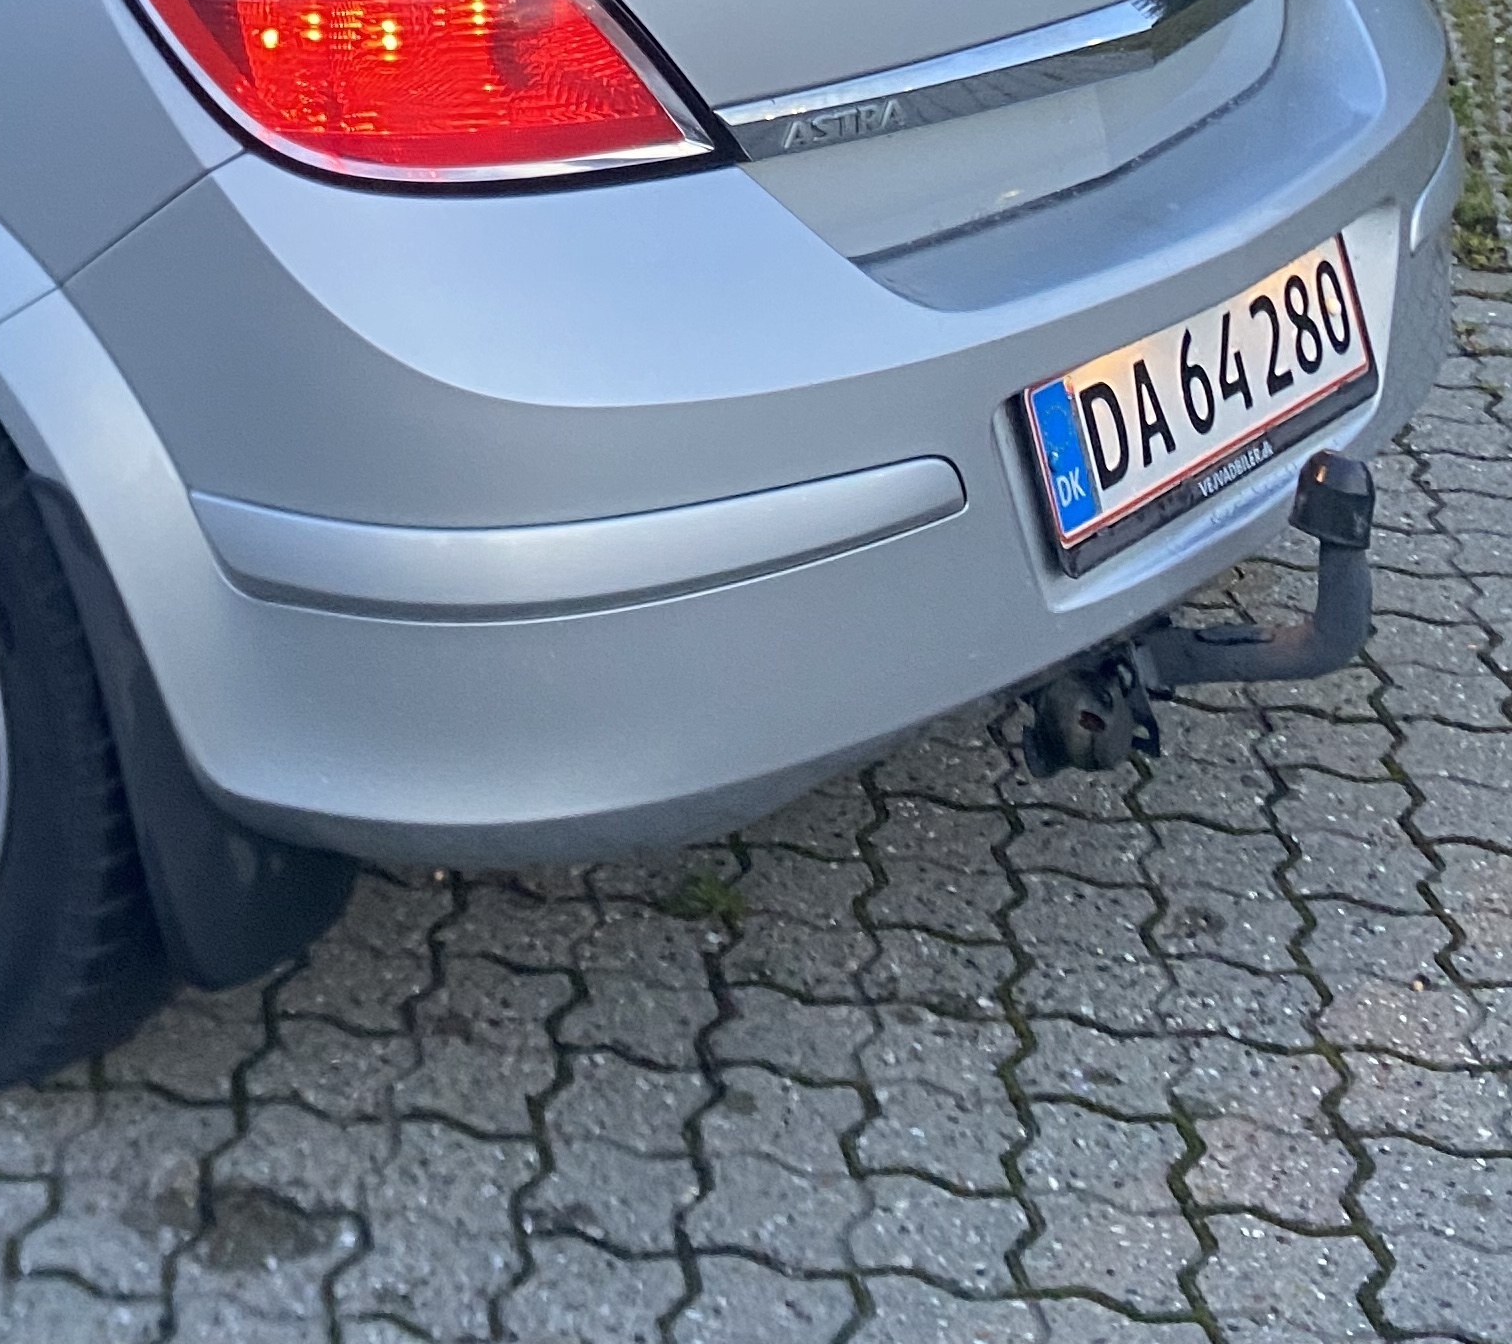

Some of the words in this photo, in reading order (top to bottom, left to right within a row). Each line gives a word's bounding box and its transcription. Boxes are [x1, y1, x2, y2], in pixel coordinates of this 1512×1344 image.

[783, 99, 905, 150] ASTRA
[1079, 359, 1176, 491] DA
[1056, 466, 1086, 508] DK
